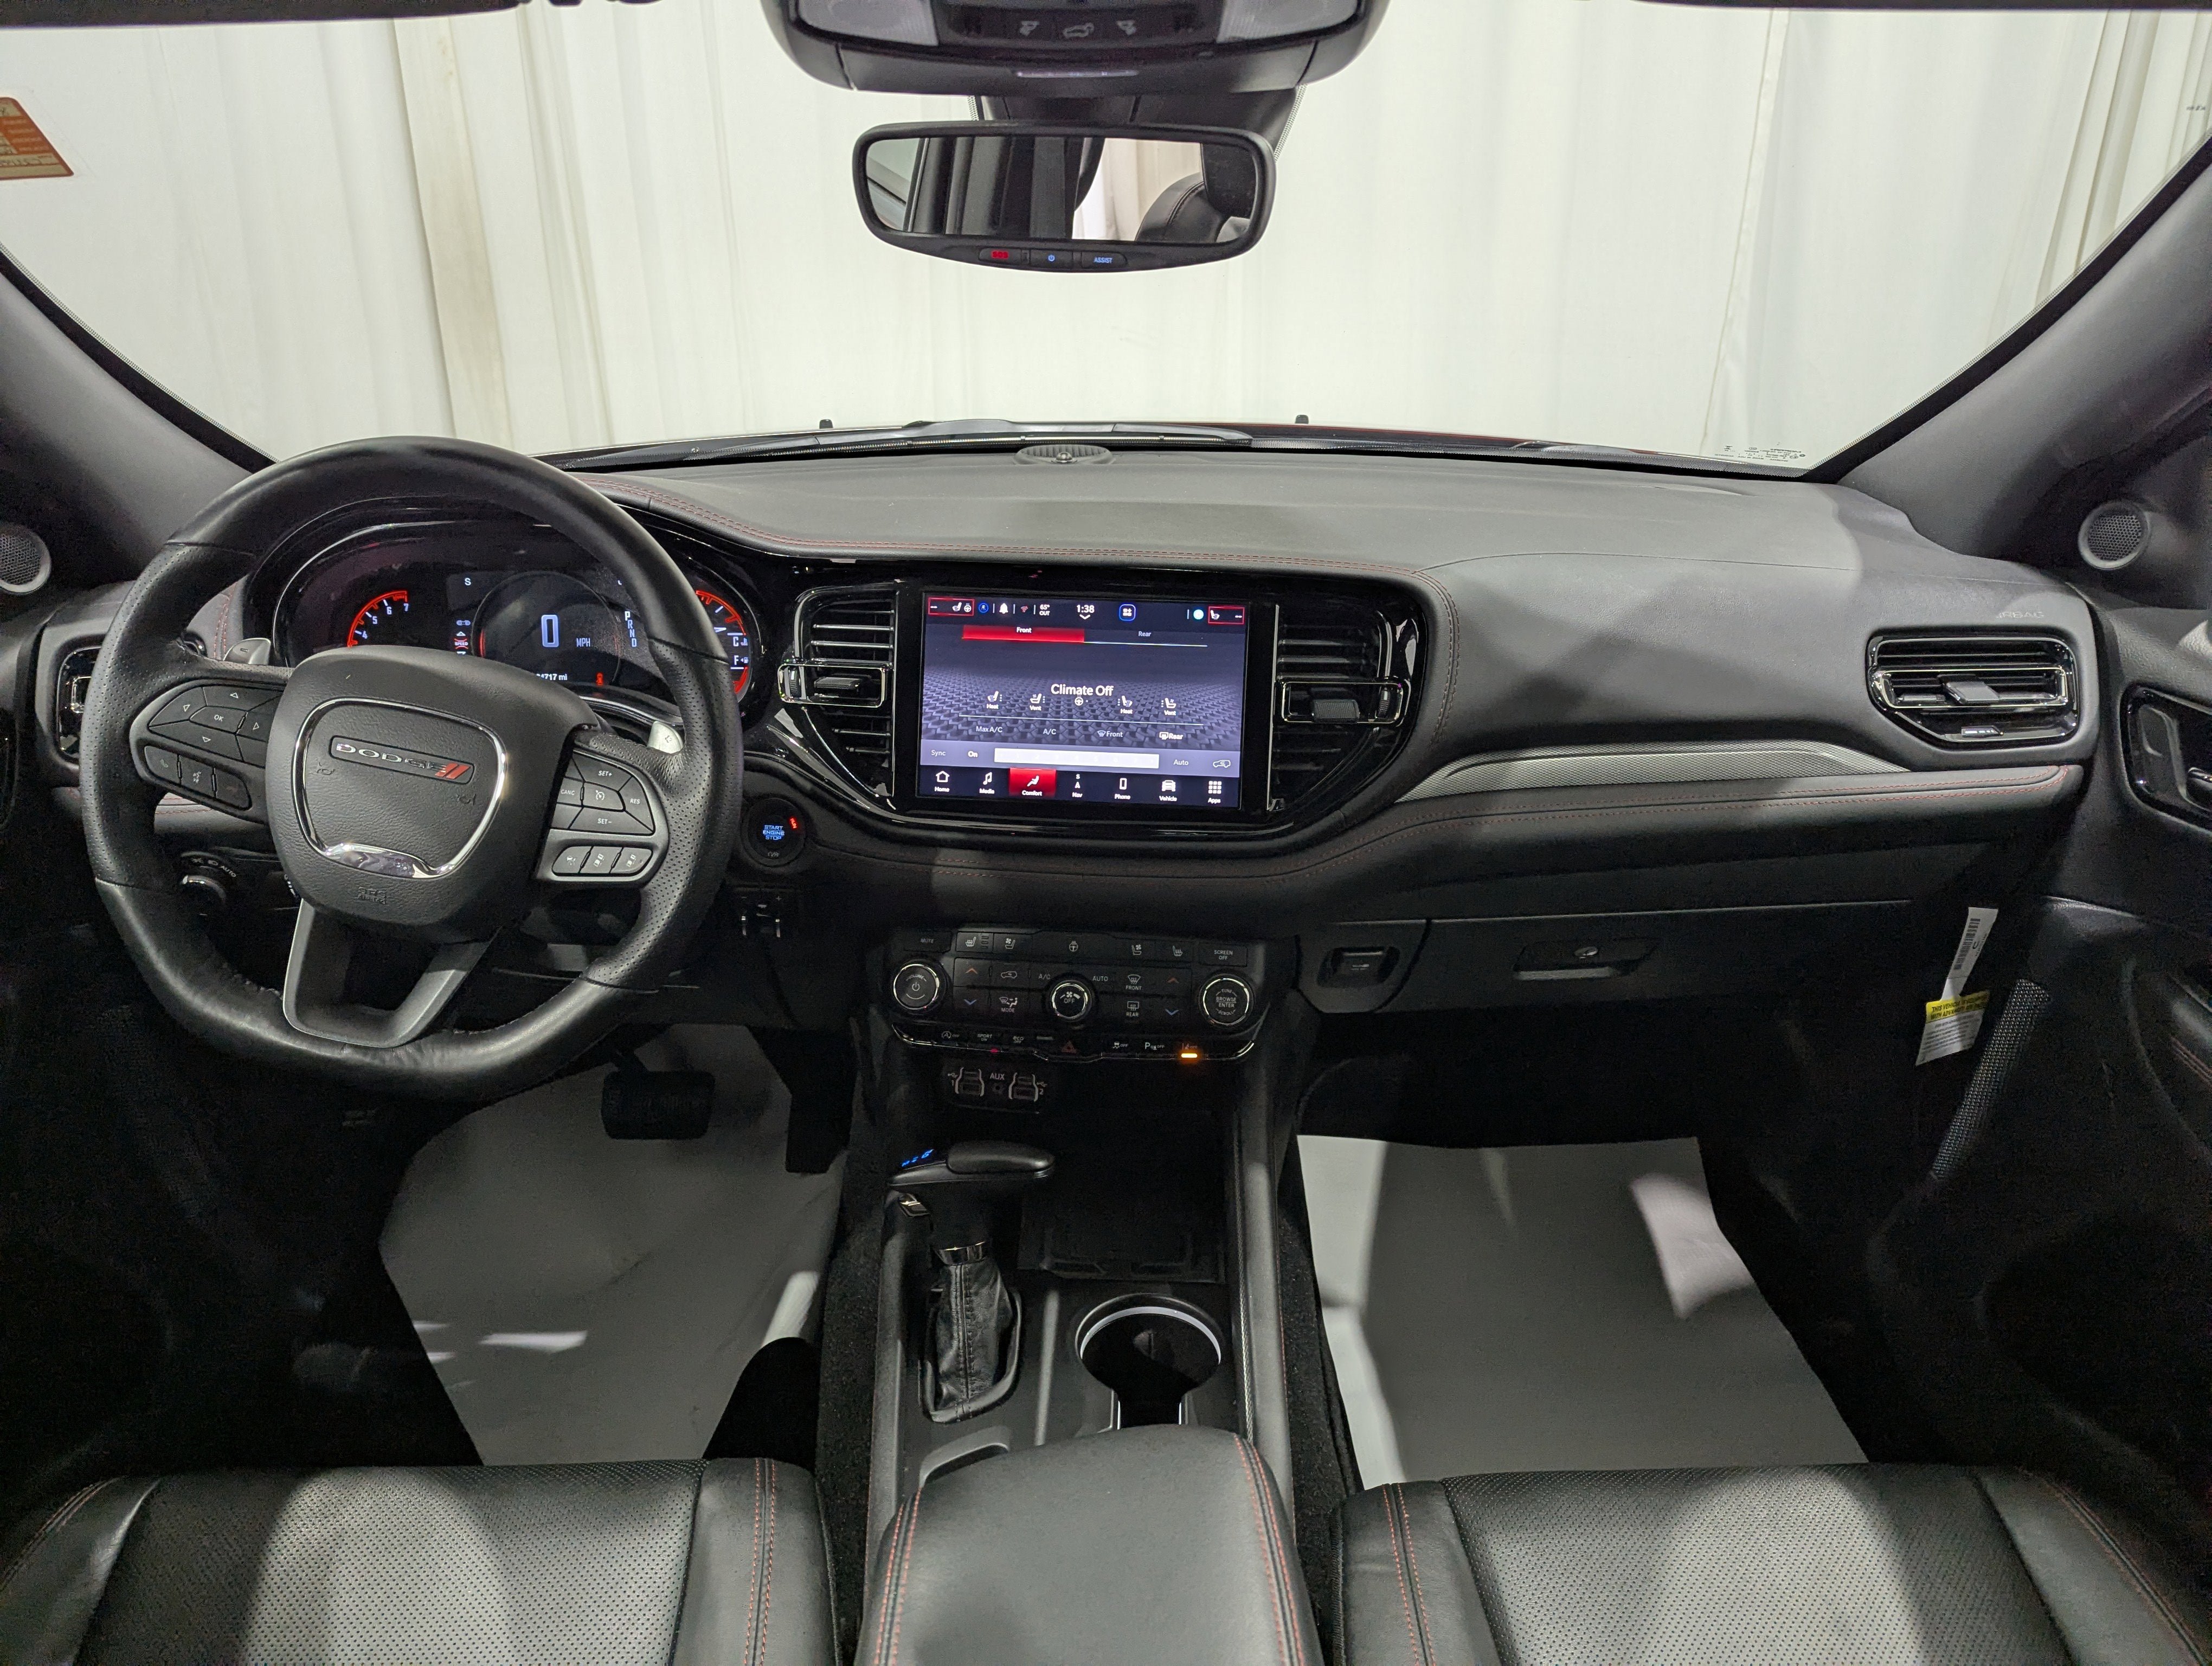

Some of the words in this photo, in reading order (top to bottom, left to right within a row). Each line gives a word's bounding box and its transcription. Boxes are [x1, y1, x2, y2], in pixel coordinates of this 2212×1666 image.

[465, 578, 471, 586] S
[387, 606, 392, 615] 6
[403, 603, 409, 612] 7
[1077, 605, 1095, 613] 1:38
[372, 616, 377, 624] 5
[362, 631, 368, 639] 4
[541, 614, 560, 648] 0
[576, 638, 590, 647] MPH
[733, 637, 739, 646] C
[734, 655, 740, 665] F
[1051, 684, 1093, 696] Climate
[1095, 685, 1114, 696] Off
[214, 714, 224, 722] OK
[336, 742, 446, 773] DODGE
[220, 866, 237, 877] AUTO
[1144, 1042, 1151, 1050] P
[989, 1073, 1006, 1081] AUX
